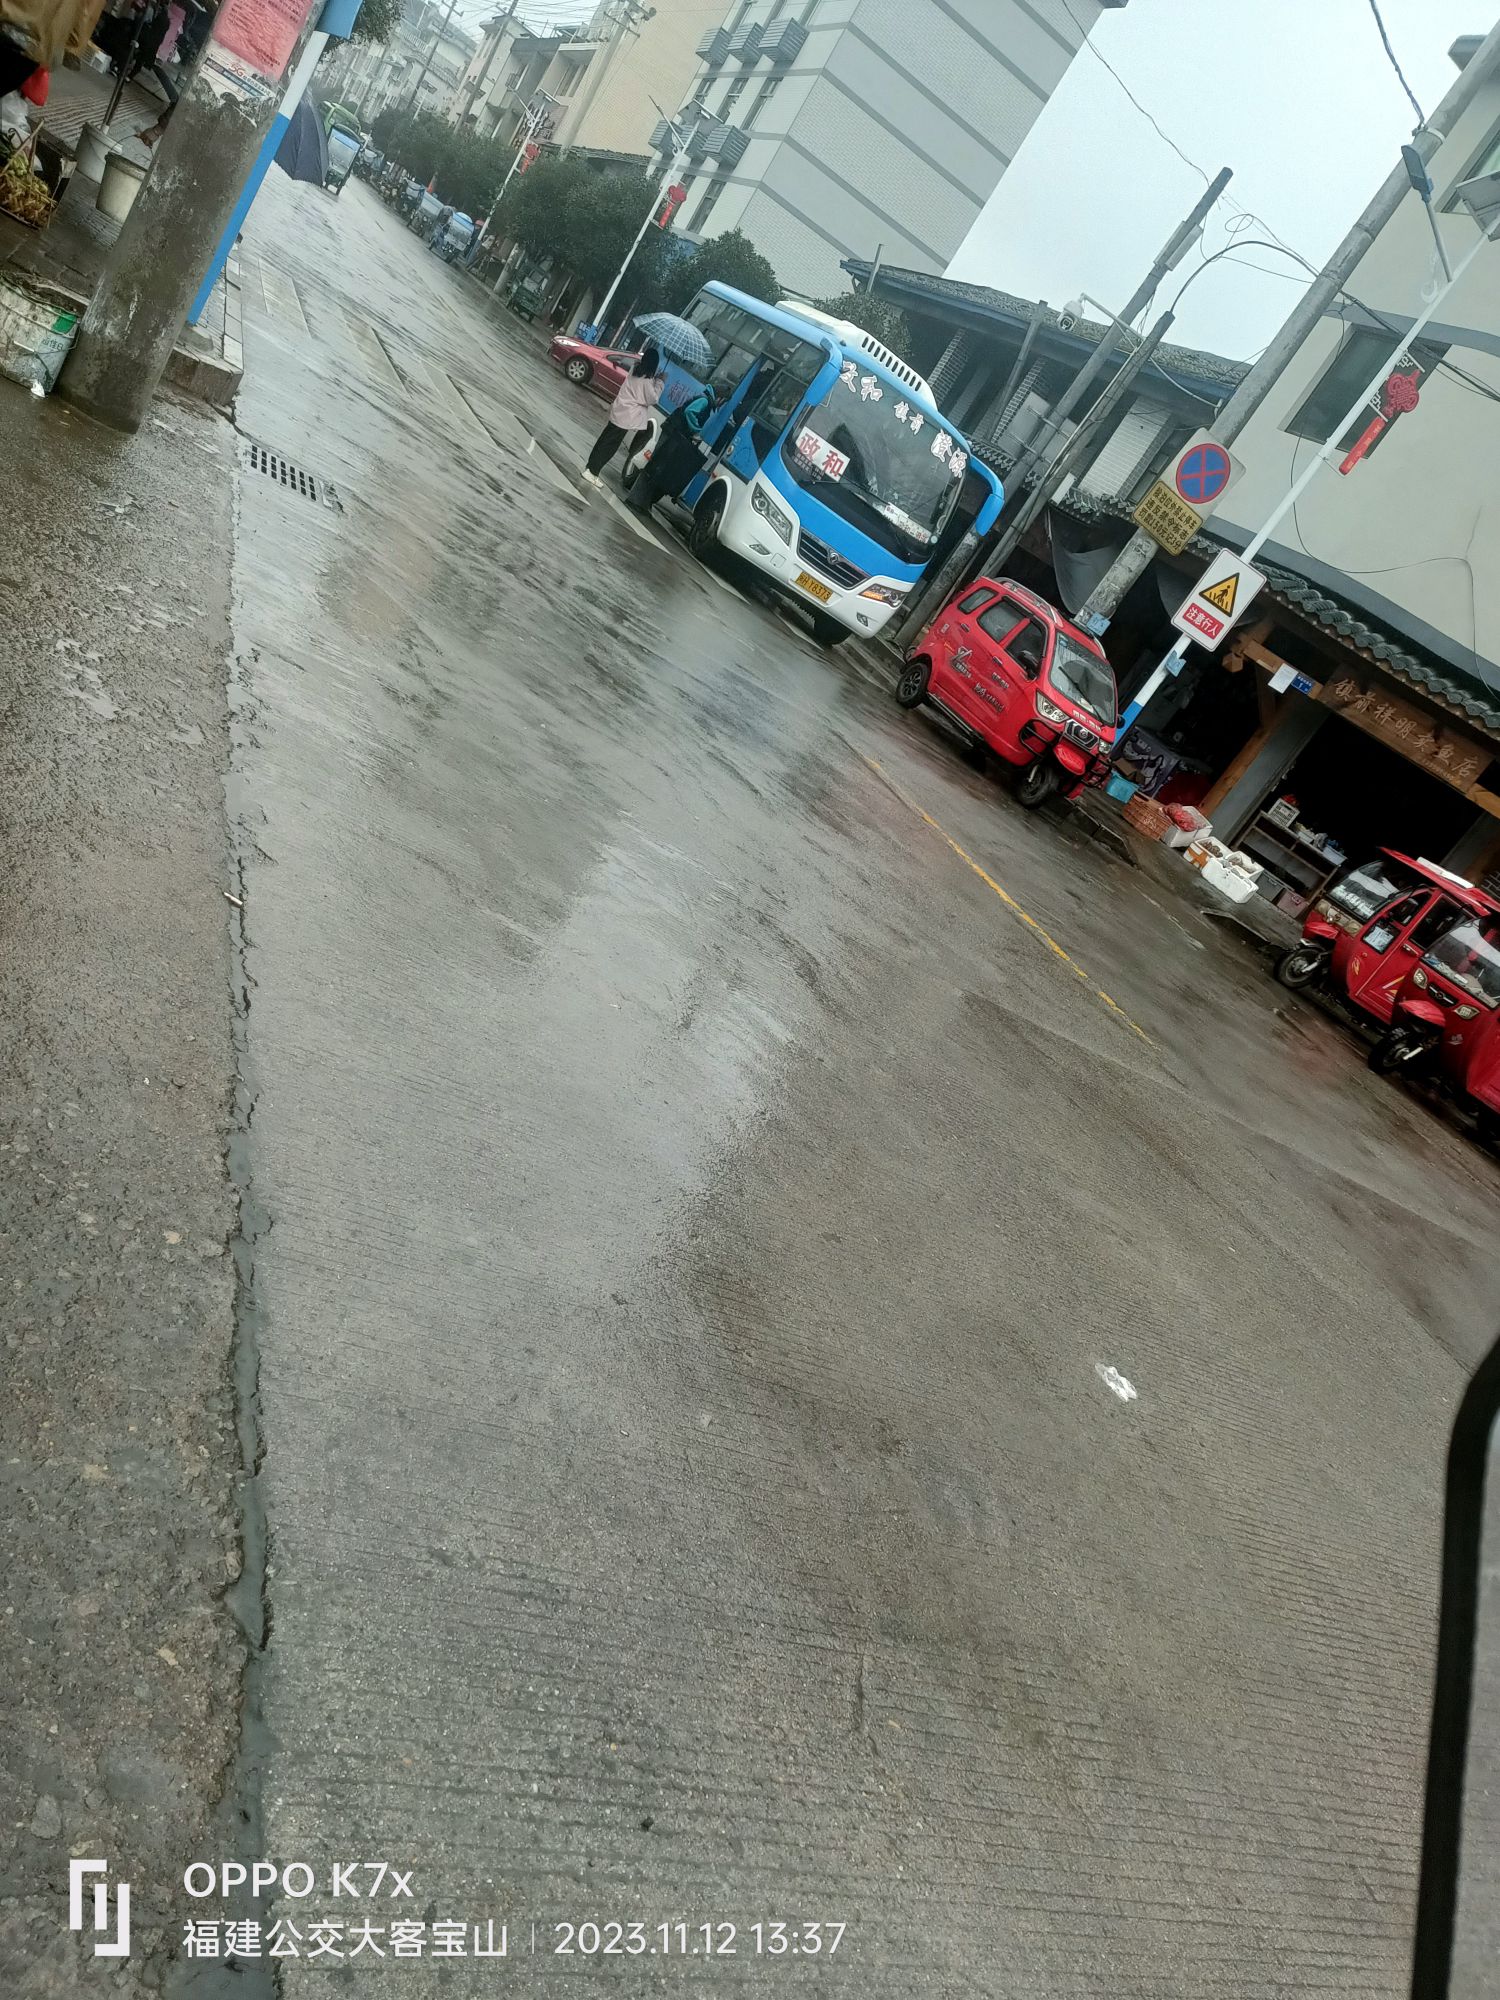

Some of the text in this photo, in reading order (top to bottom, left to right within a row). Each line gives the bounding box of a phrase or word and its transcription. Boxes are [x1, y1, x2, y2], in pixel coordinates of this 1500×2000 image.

[799, 432, 844, 478] 政和
[1138, 509, 1182, 551] 罚款150元记3分
[1145, 498, 1190, 540] 违反禁令标志
[1185, 606, 1221, 636] 注意行人
